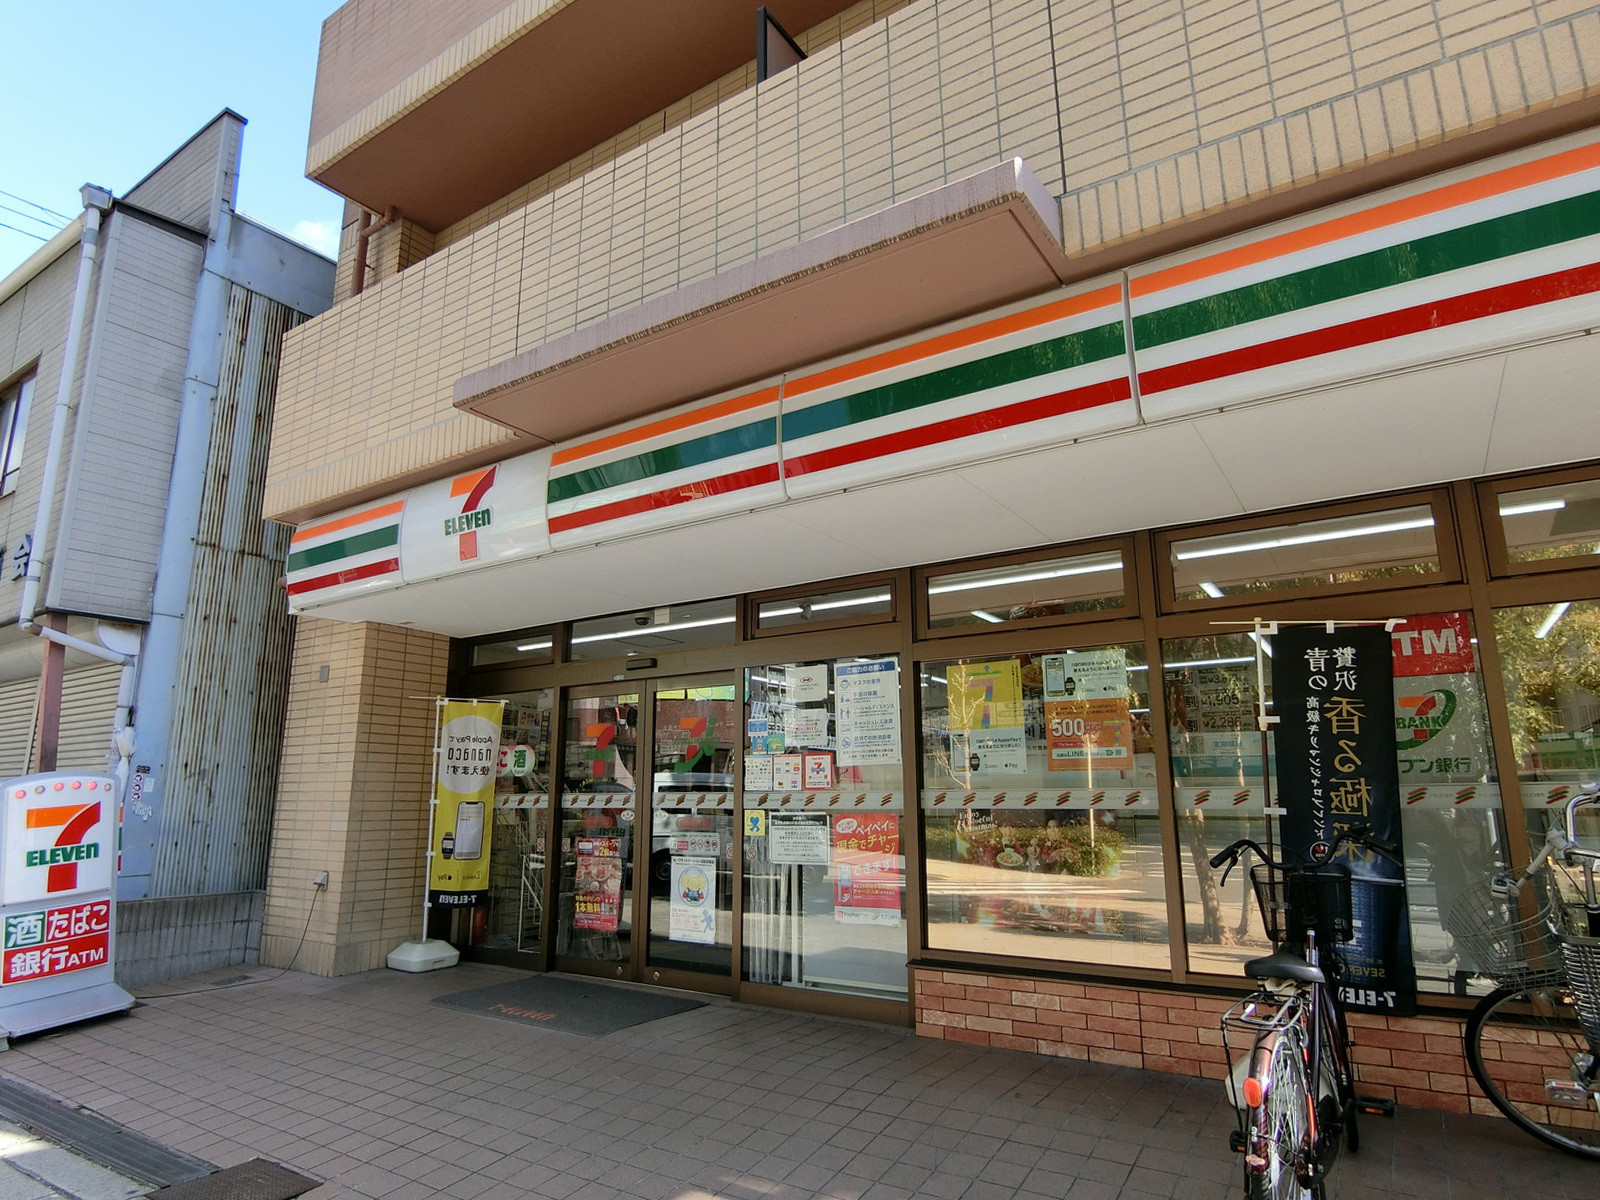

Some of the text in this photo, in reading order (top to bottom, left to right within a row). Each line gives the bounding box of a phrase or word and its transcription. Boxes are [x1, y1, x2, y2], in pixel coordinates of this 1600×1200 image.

[1391, 628, 1458, 657] TM
[1052, 717, 1085, 738] 500
[513, 749, 527, 768] 酒
[853, 858, 897, 876] できます!
[7, 917, 44, 948] 酒
[47, 904, 109, 942] たばこ
